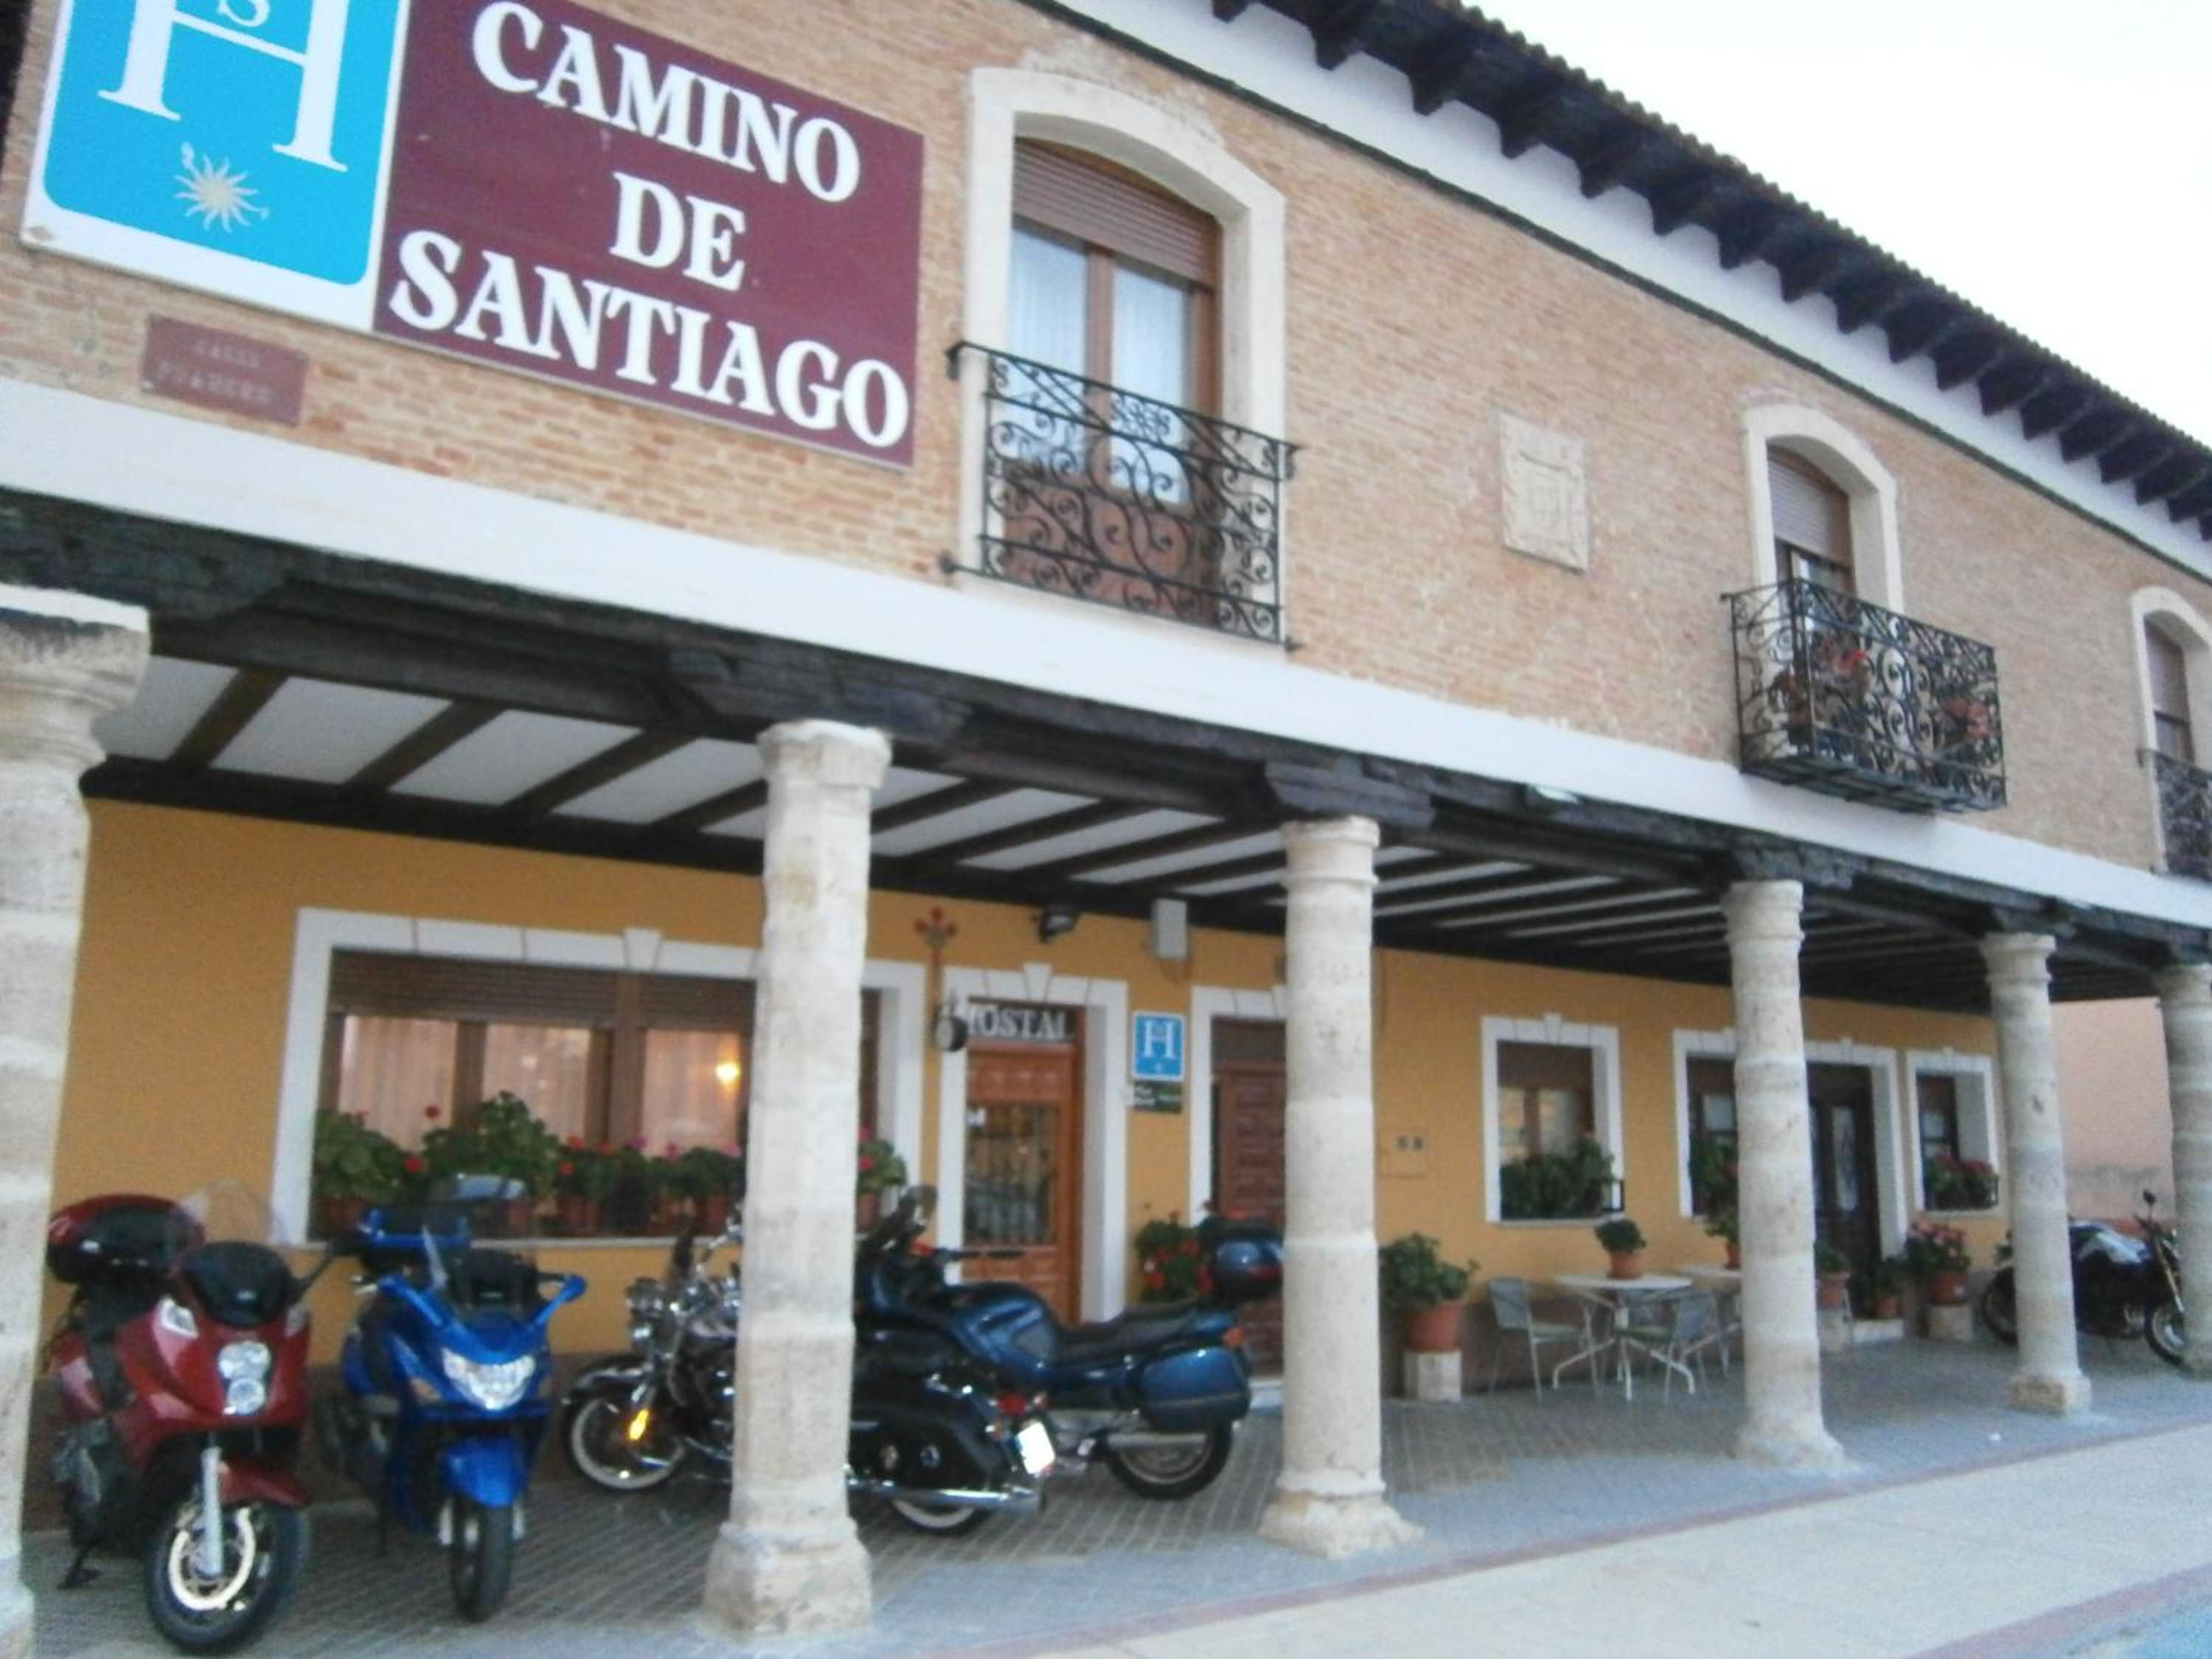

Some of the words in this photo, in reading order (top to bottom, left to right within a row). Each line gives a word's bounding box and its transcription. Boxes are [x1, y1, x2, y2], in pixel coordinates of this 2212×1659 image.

[472, 1, 861, 203] CAMINO
[610, 171, 746, 292] DE
[388, 230, 909, 448] SANTIAGO
